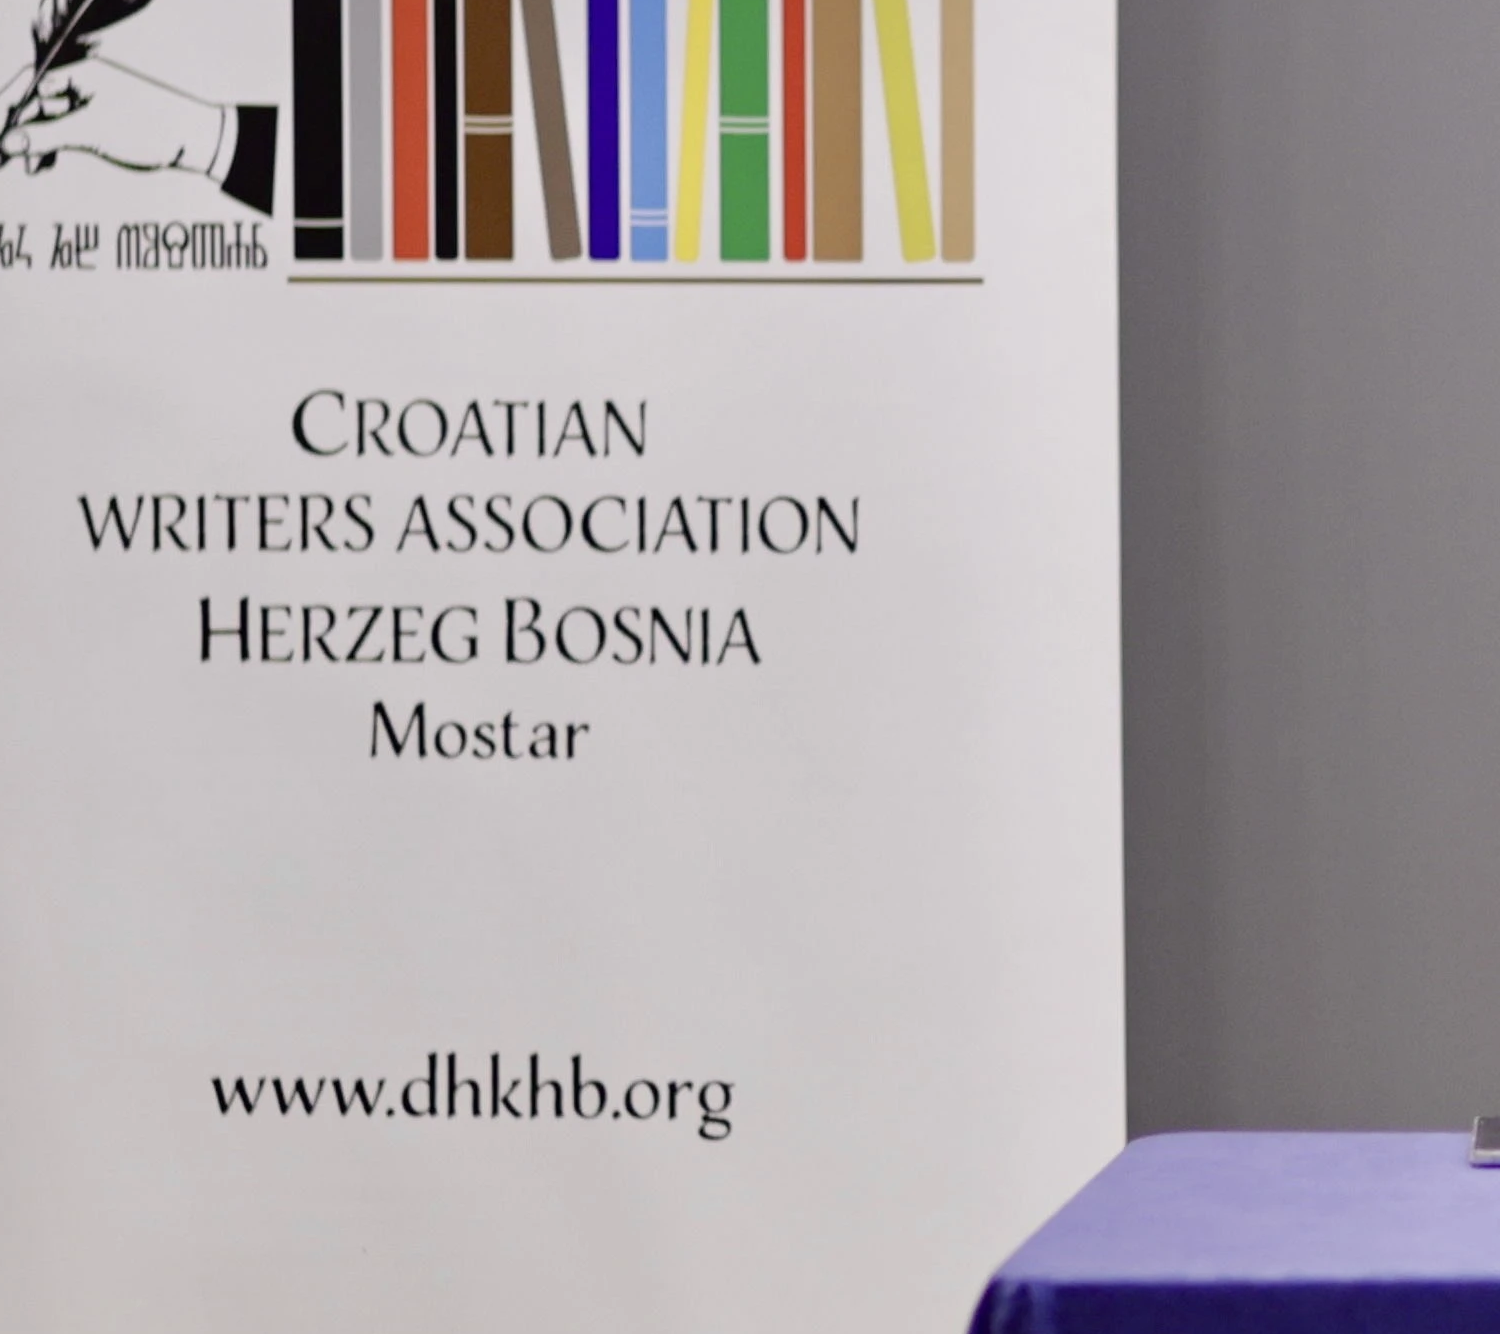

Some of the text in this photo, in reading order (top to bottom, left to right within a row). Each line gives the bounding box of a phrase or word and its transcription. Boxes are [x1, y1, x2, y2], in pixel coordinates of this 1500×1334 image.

[291, 389, 648, 458] CROATIAN
[77, 494, 860, 555] WRITERS ASSOCIATION
[199, 595, 762, 666] HERZEG BOSNIA
[370, 700, 590, 760] Mostar
[211, 1051, 735, 1142] www.dhkhb.org
